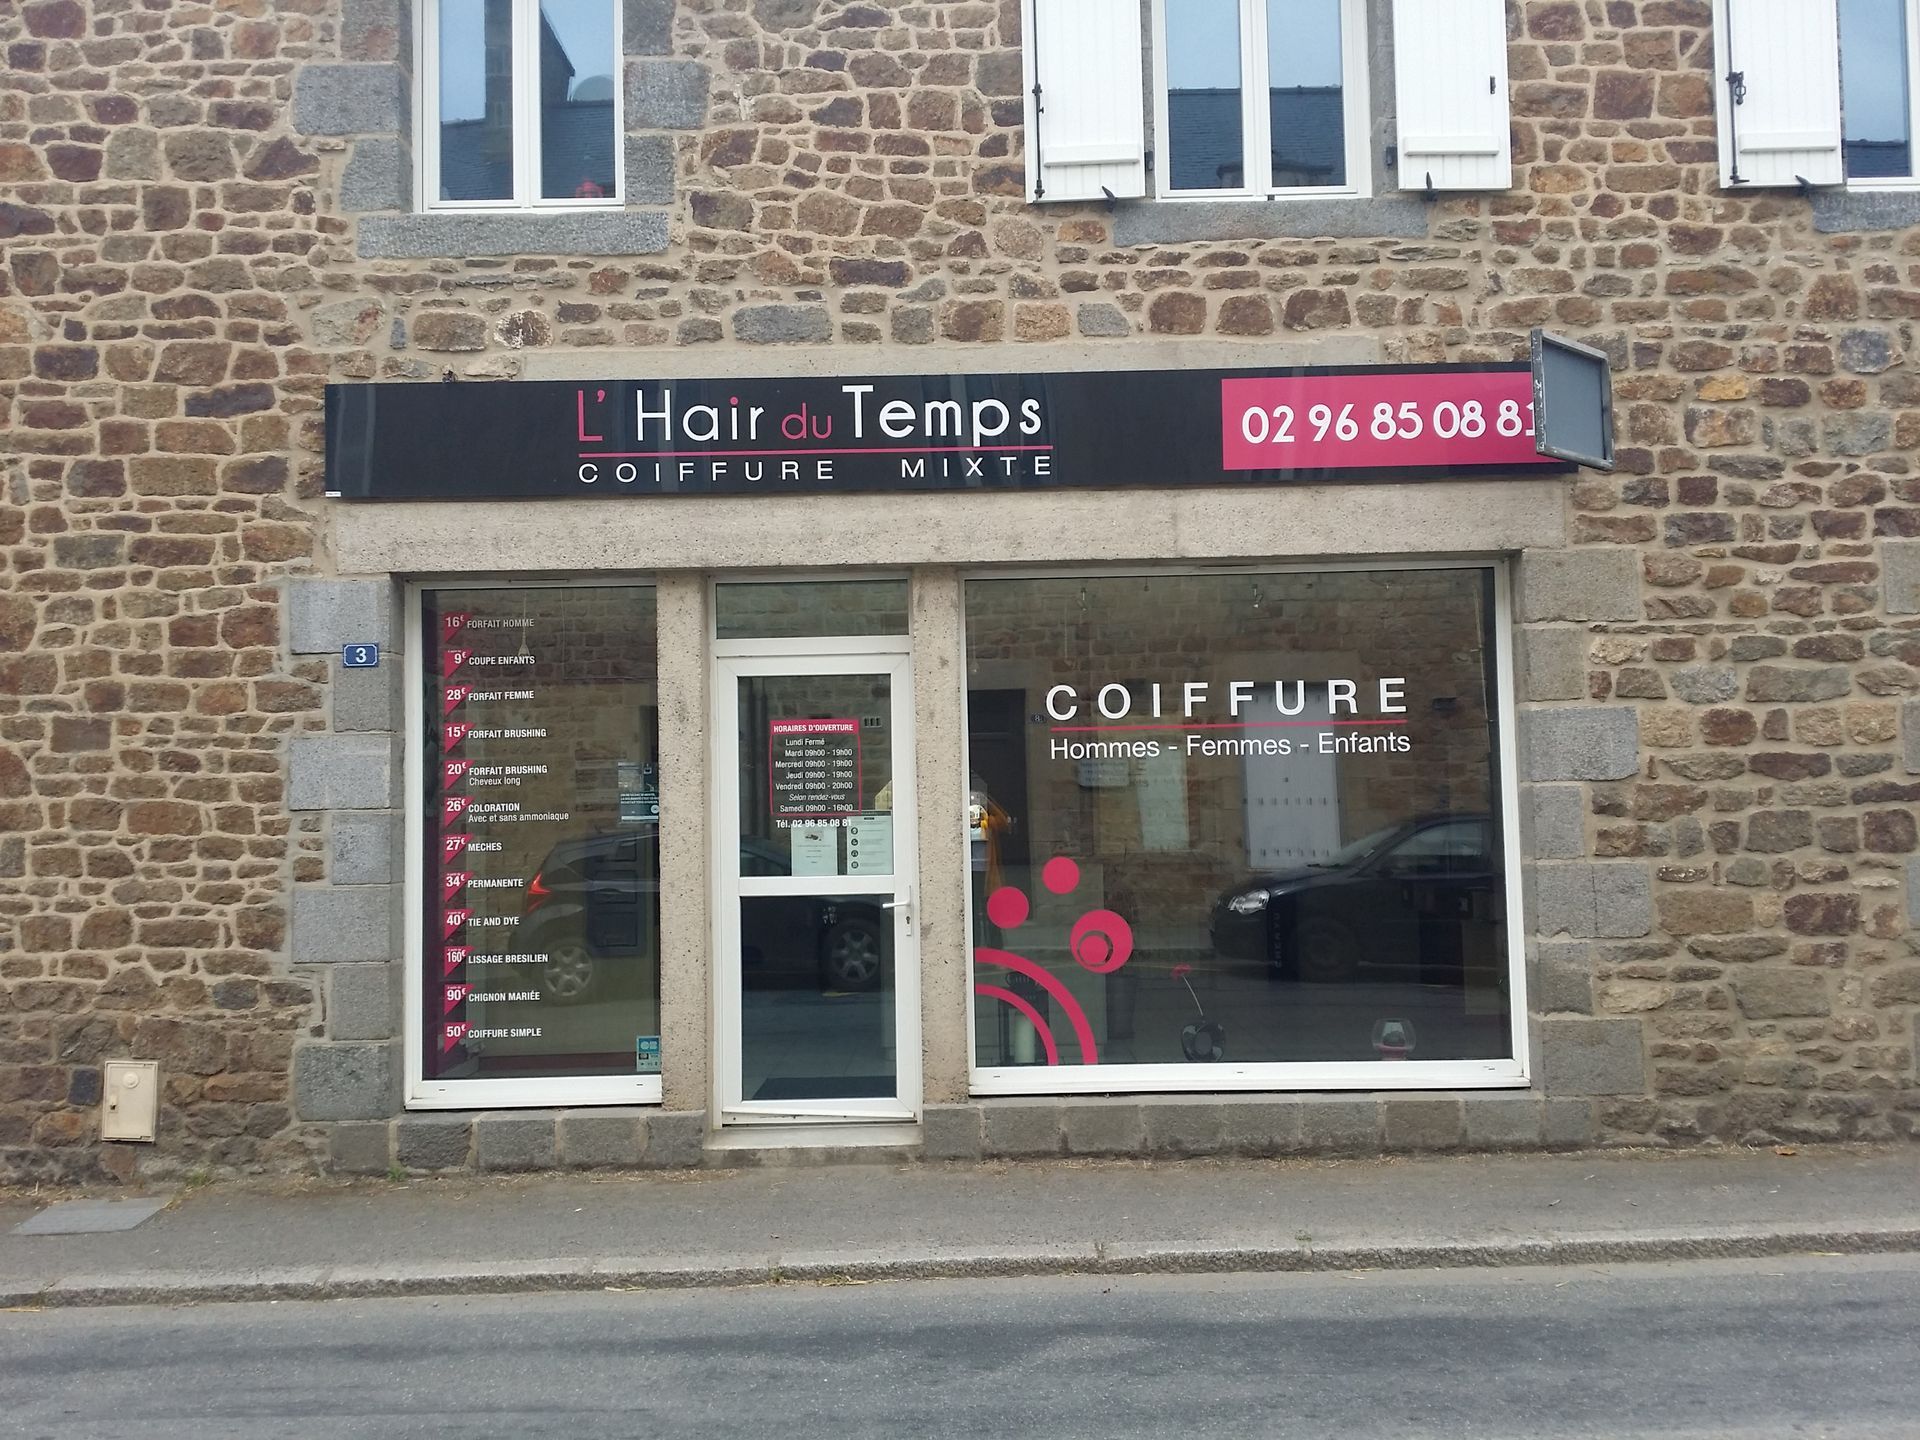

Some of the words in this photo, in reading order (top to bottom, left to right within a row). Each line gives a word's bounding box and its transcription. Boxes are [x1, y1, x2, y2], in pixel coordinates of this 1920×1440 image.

[578, 390, 605, 441] L'
[637, 390, 764, 441] Hair
[782, 403, 831, 439] du
[843, 385, 1041, 446] Temps
[1242, 406, 1294, 443] 02
[1309, 404, 1358, 441] 96
[1371, 402, 1422, 440] 85
[1433, 401, 1485, 438] 08
[579, 461, 833, 482] COIFFURE
[902, 456, 1050, 477] MIXTE
[466, 620, 500, 628] FORFAIT
[503, 619, 534, 627] HOMME
[356, 648, 366, 662] 3
[468, 657, 495, 665] COUPE
[498, 656, 535, 664] ENFANTS
[468, 692, 502, 700] FORFAIT
[504, 691, 534, 699] FEMME
[1046, 678, 1406, 720] COIFFURE
[468, 730, 502, 738] FORFAIT
[504, 729, 546, 737] BRUSHING
[1051, 739, 1159, 759] Hommes
[1187, 735, 1291, 755] Femmes
[1319, 732, 1410, 753] Enfants
[469, 767, 502, 775] FORFAIT
[505, 765, 547, 774] BRUSHING
[504, 777, 520, 785] long
[468, 803, 519, 812] COLORATION
[489, 814, 497, 822] et
[519, 812, 568, 821] ammoniaque
[468, 843, 501, 851] MECHES
[467, 879, 523, 887] PERMANENTE
[468, 918, 481, 926] TIE
[483, 918, 500, 926] AND
[503, 917, 519, 925] DYE
[468, 955, 502, 963] LISSAGE
[505, 954, 548, 962] BRESILIEN
[468, 993, 505, 1001] CHIGNON
[508, 991, 540, 1000] MARIÉE
[468, 1029, 508, 1038] COIFFURE
[510, 1028, 541, 1037] SIMPLE
